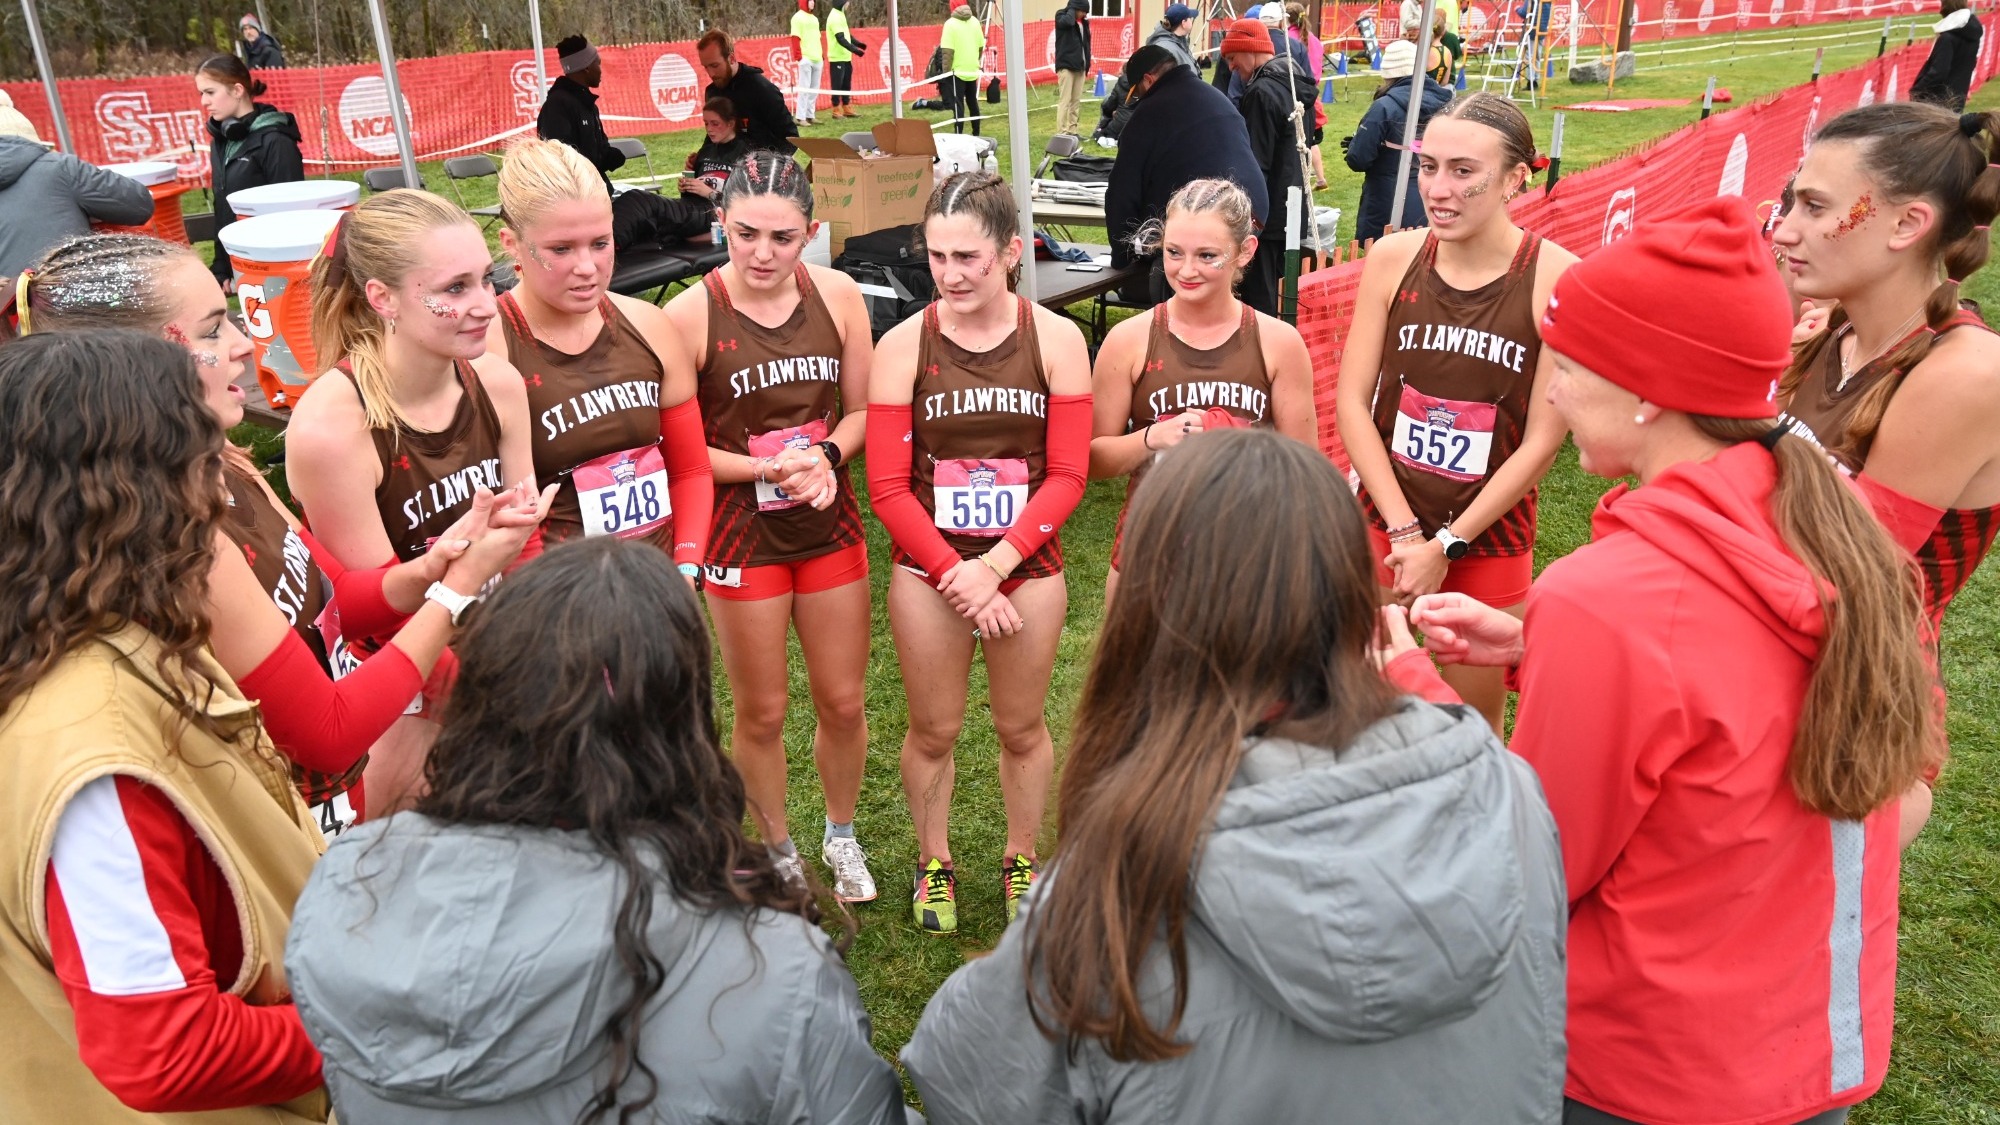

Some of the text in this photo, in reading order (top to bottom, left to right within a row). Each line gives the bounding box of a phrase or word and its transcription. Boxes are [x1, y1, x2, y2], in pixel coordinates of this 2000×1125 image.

[884, 65, 912, 79] NAA
[657, 86, 698, 105] NCAA
[351, 114, 396, 139] NCA
[816, 175, 847, 186] treefree
[877, 172, 914, 184] treefree
[238, 283, 274, 339] G
[1398, 324, 1526, 373] ST. LAWRENCE
[730, 356, 840, 398] ST. LAWRENCE
[541, 380, 659, 441] ST. LAWRENCE
[925, 387, 1046, 421] ST. LAWRENCE
[1149, 381, 1267, 419] ST. LAWRENCE
[1406, 423, 1471, 472] 552
[403, 490, 431, 530] ST.
[600, 480, 660, 533] 548
[952, 490, 1013, 528] 550
[273, 573, 305, 627] ST.
